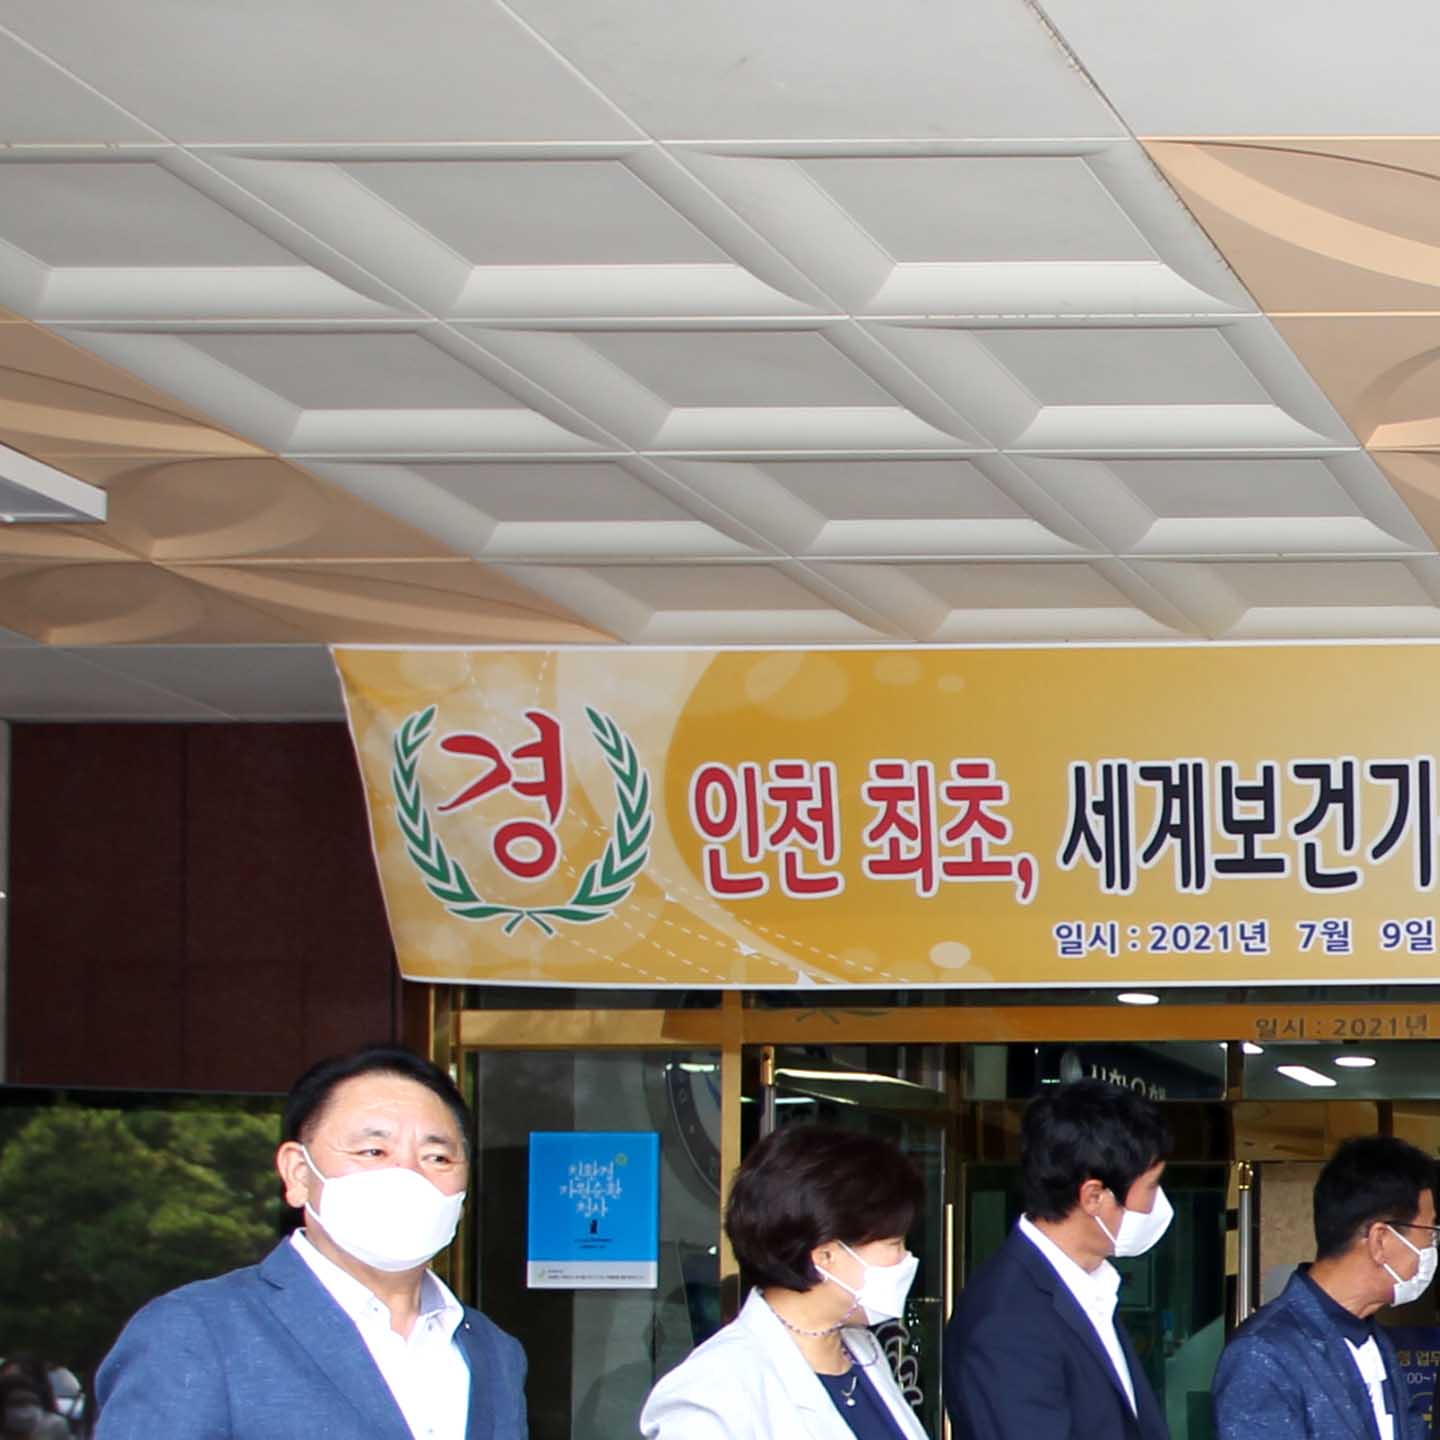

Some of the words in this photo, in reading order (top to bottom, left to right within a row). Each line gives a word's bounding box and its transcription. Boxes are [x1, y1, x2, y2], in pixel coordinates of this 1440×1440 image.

[438, 710, 566, 879] 경
[692, 764, 838, 896] 인천
[866, 763, 1034, 899] 최초,
[1054, 922, 1120, 954] 일시
[1150, 922, 1268, 952] 2021년
[1299, 921, 1351, 952] 7월
